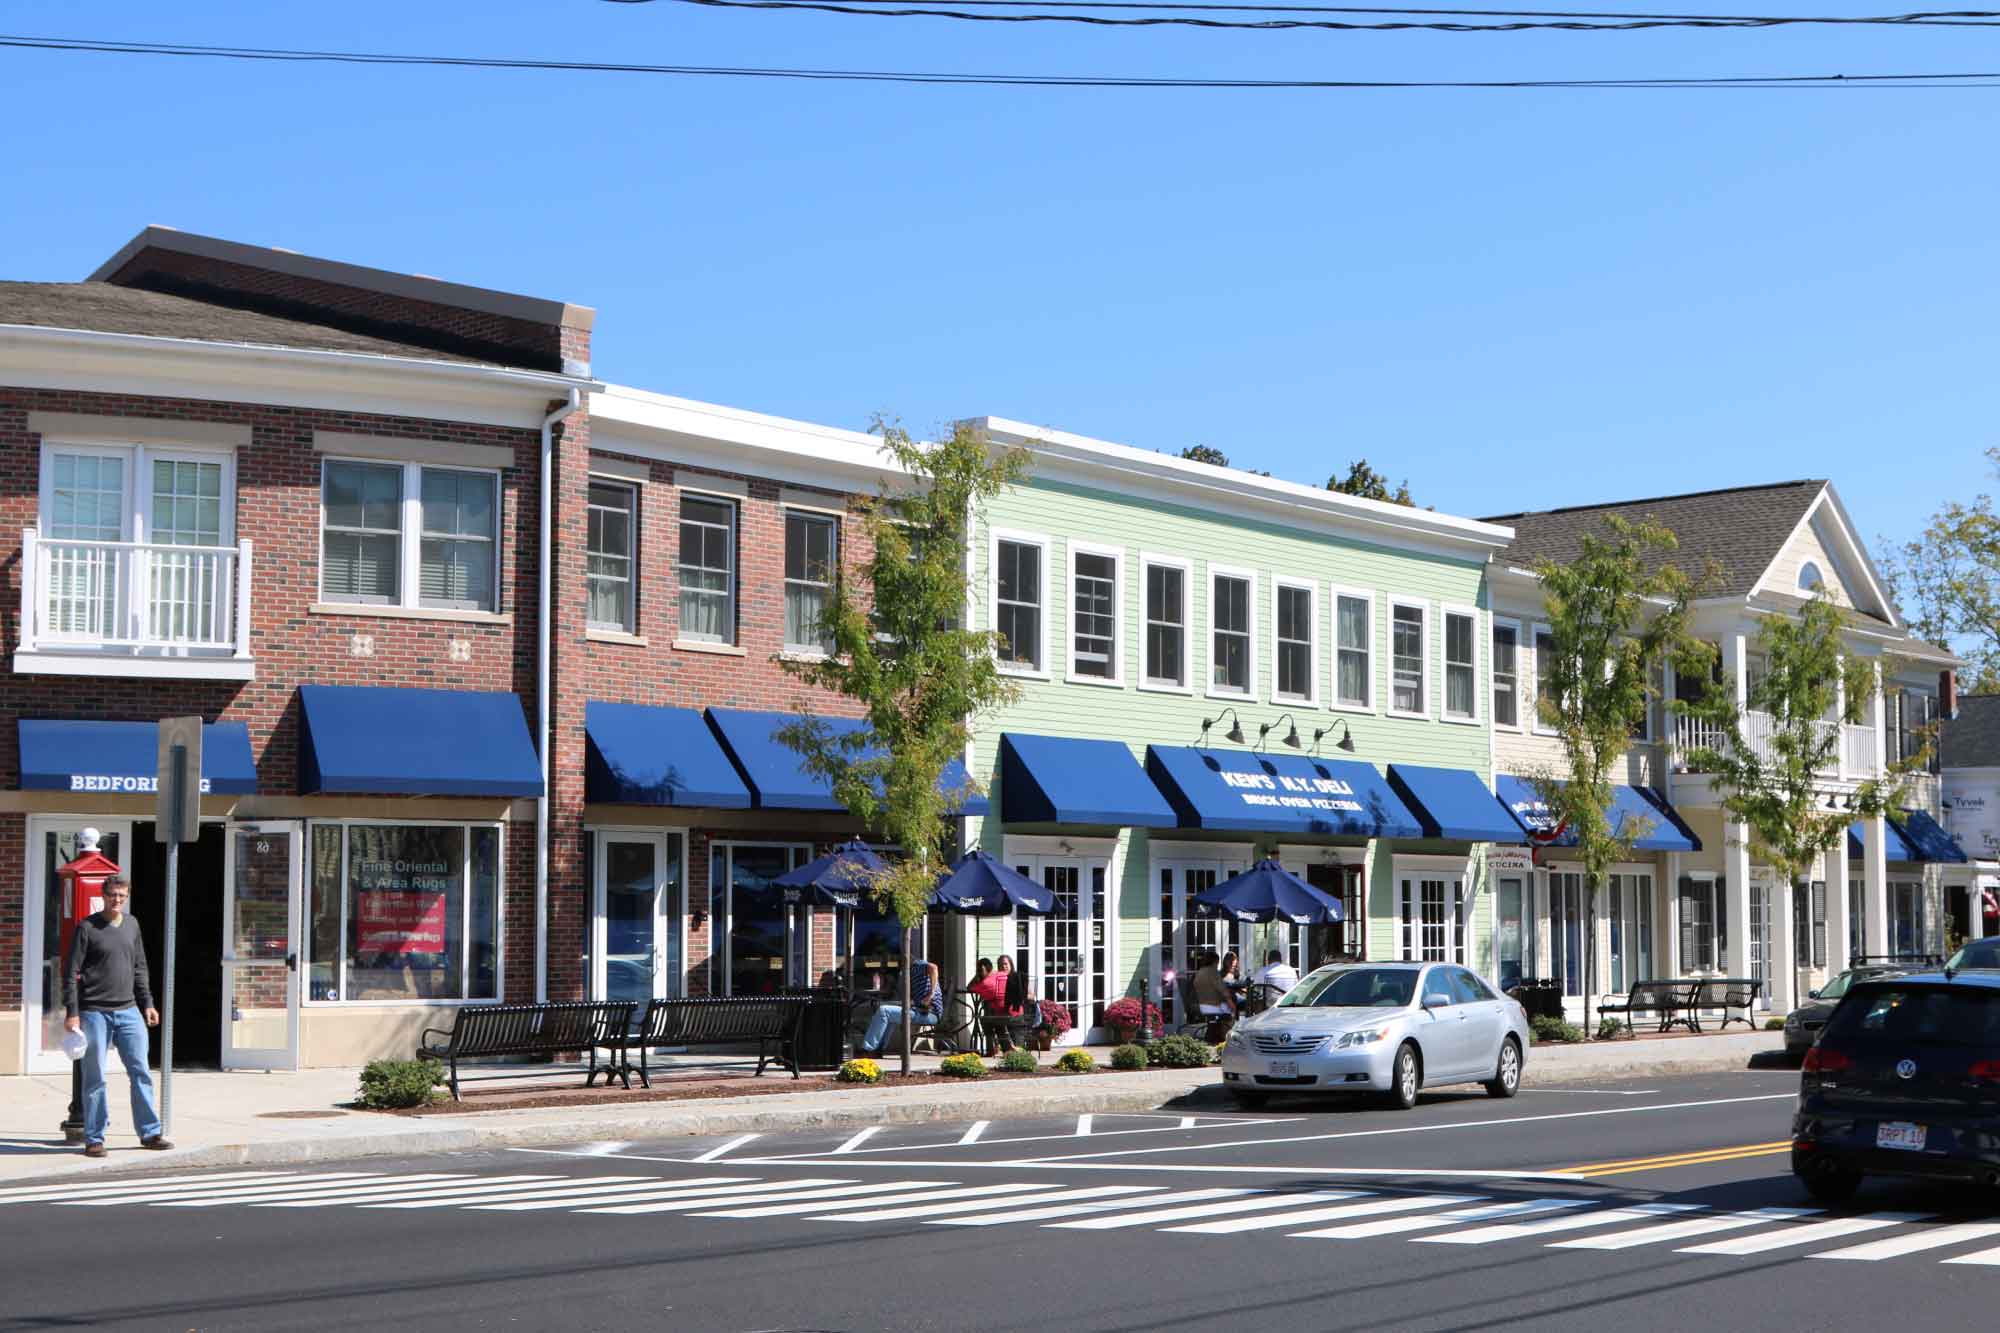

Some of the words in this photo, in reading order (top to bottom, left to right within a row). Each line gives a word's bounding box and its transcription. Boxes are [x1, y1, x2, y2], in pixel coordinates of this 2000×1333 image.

[70, 775, 160, 791] BEDFOR
[1221, 771, 1276, 790] KEN'S
[1312, 778, 1354, 796] DELI
[1955, 796, 1985, 810] Tyvek
[362, 860, 392, 872] Fine
[395, 859, 448, 873] Oriental
[1488, 861, 1525, 869] CUCINA
[376, 878, 407, 889] Area
[412, 876, 446, 891] Rugs
